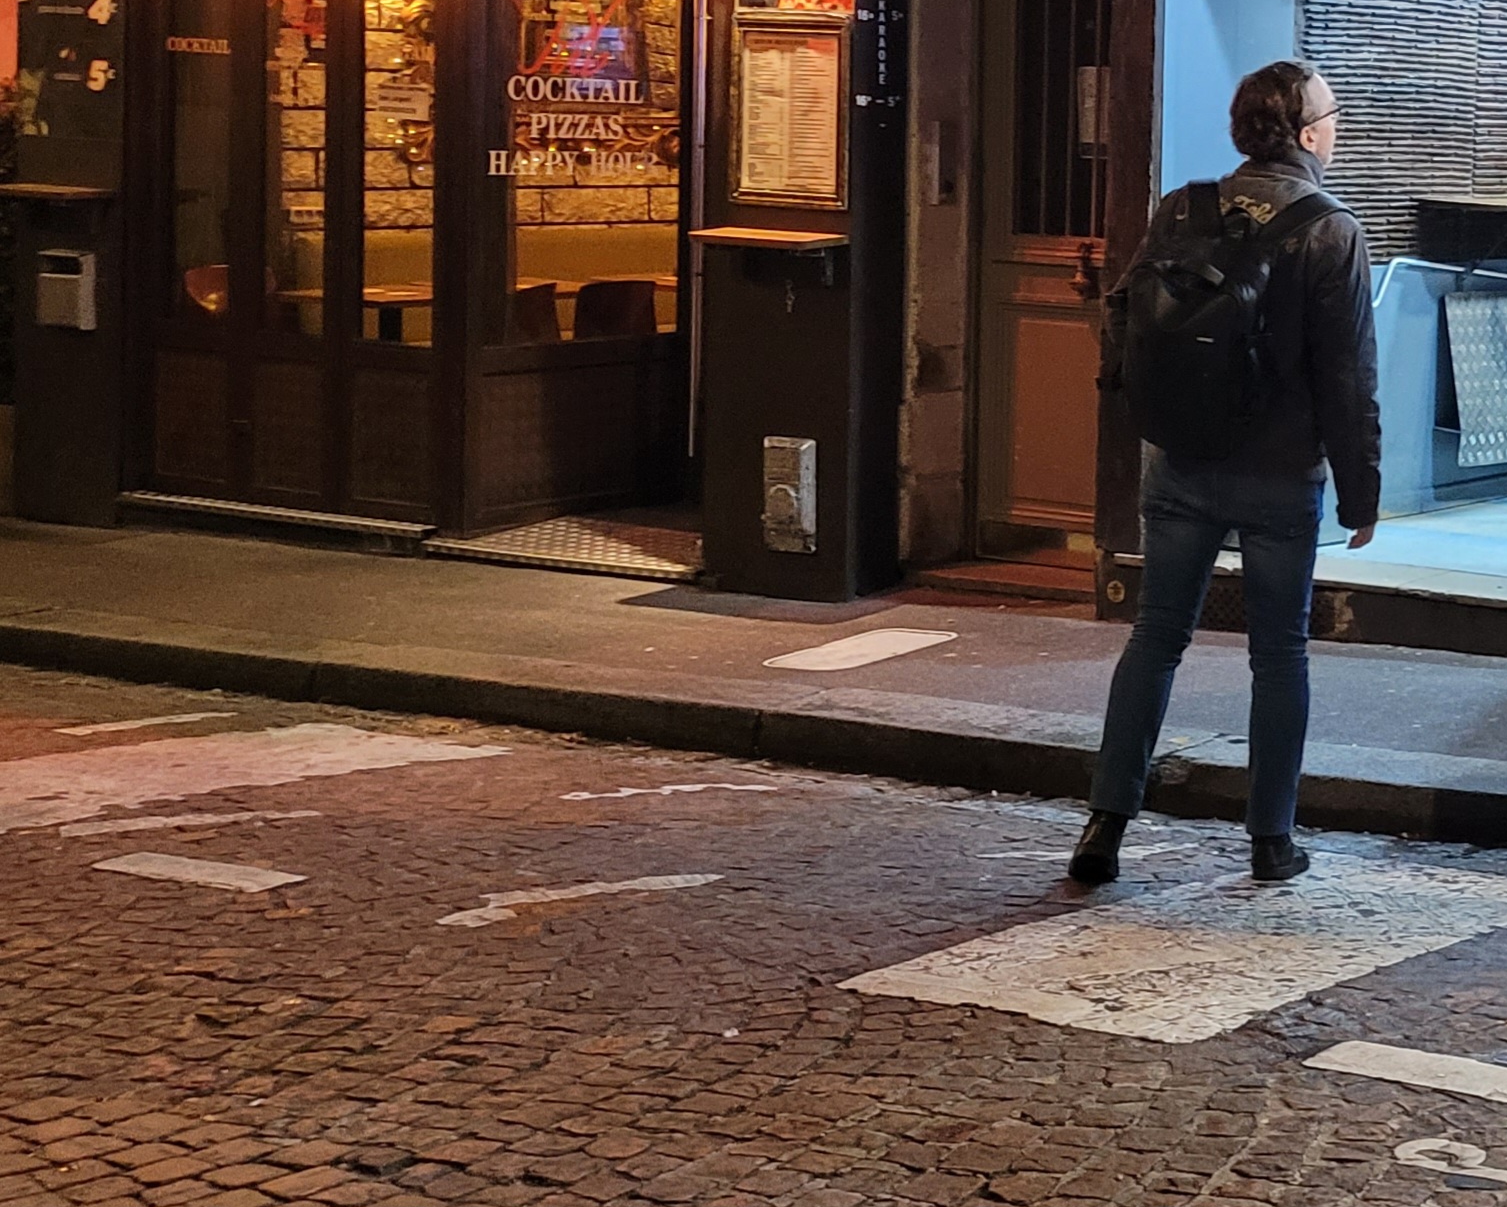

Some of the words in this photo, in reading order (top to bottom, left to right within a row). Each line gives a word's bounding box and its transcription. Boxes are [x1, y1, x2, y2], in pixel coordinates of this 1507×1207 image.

[166, 37, 231, 55] COCKTAIL
[878, 0, 886, 85] KARAOKE
[507, 75, 644, 104] COCKTAIL
[530, 113, 624, 140] PIZZAS
[487, 149, 578, 176] HAPPY
